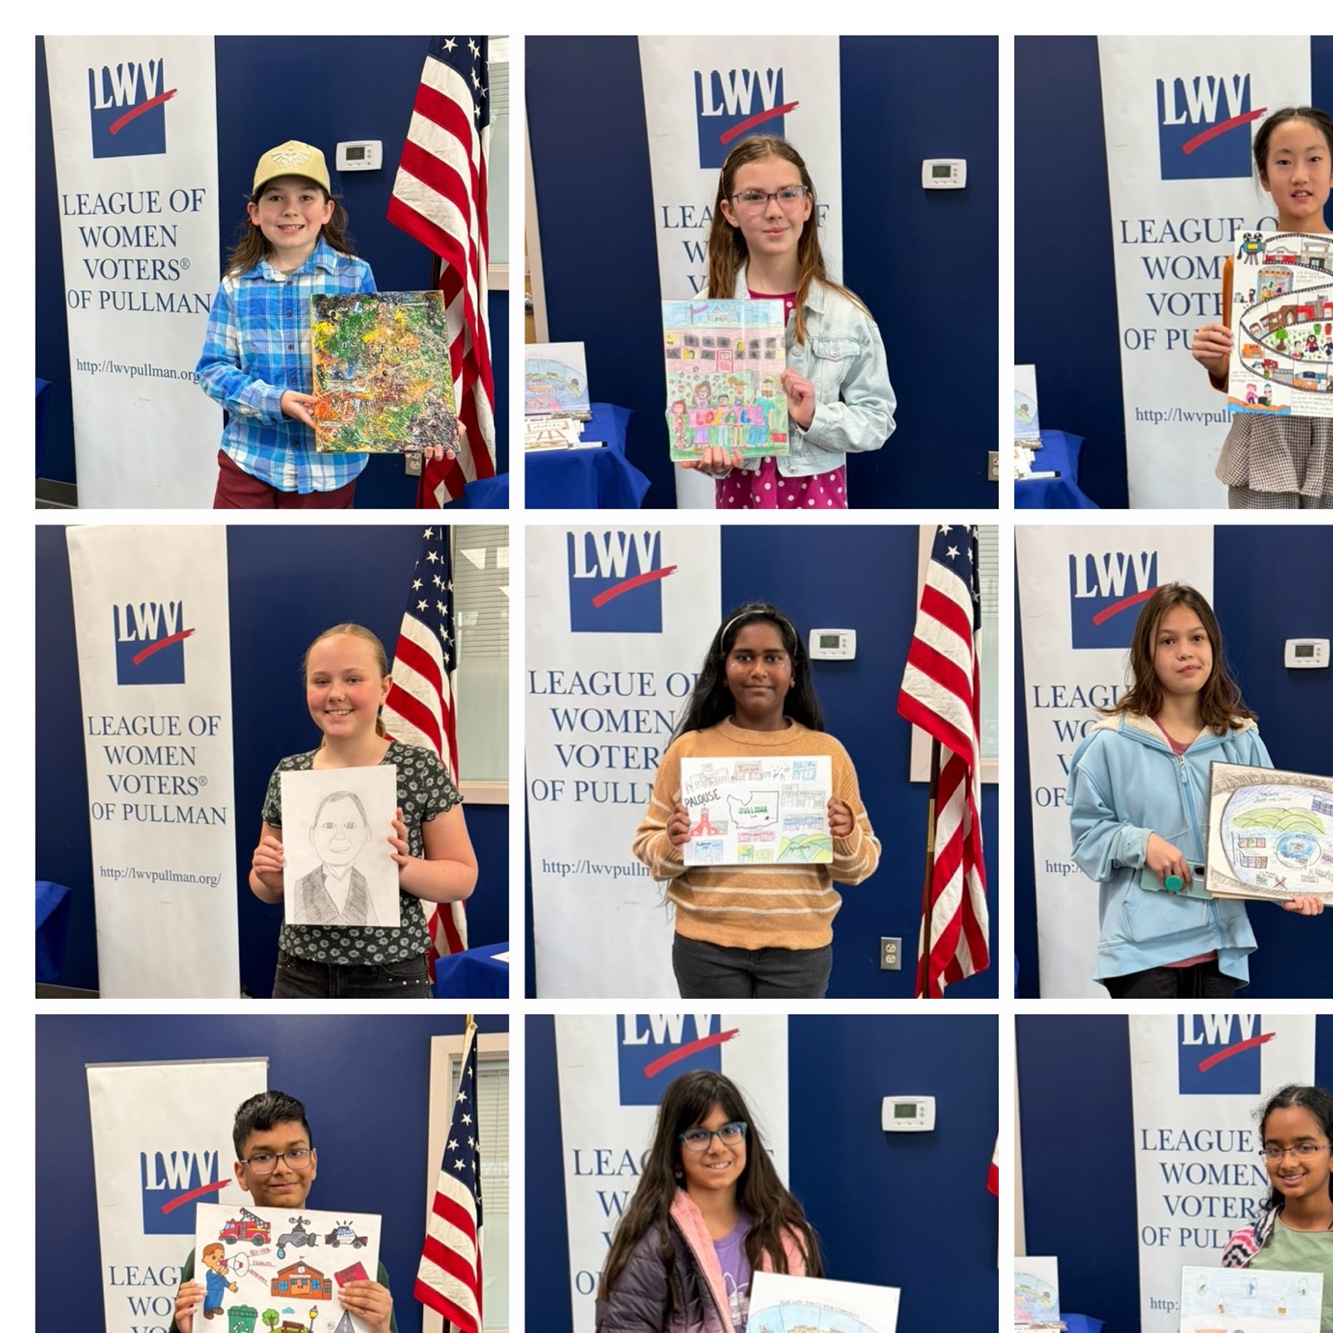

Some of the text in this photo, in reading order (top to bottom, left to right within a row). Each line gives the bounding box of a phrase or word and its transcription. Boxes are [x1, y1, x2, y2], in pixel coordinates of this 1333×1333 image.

[94, 58, 163, 109] LWV
[63, 189, 206, 215] LEAGUE OF
[78, 225, 177, 247] WOMEN
[68, 290, 211, 313] OF PULLMAN
[117, 599, 182, 642] LWV
[88, 715, 222, 737] LEAGUE OF
[103, 745, 196, 767] WOMEN
[92, 804, 227, 825] OF PULLMAN
[100, 866, 222, 888] http://lwvpullman.org/
